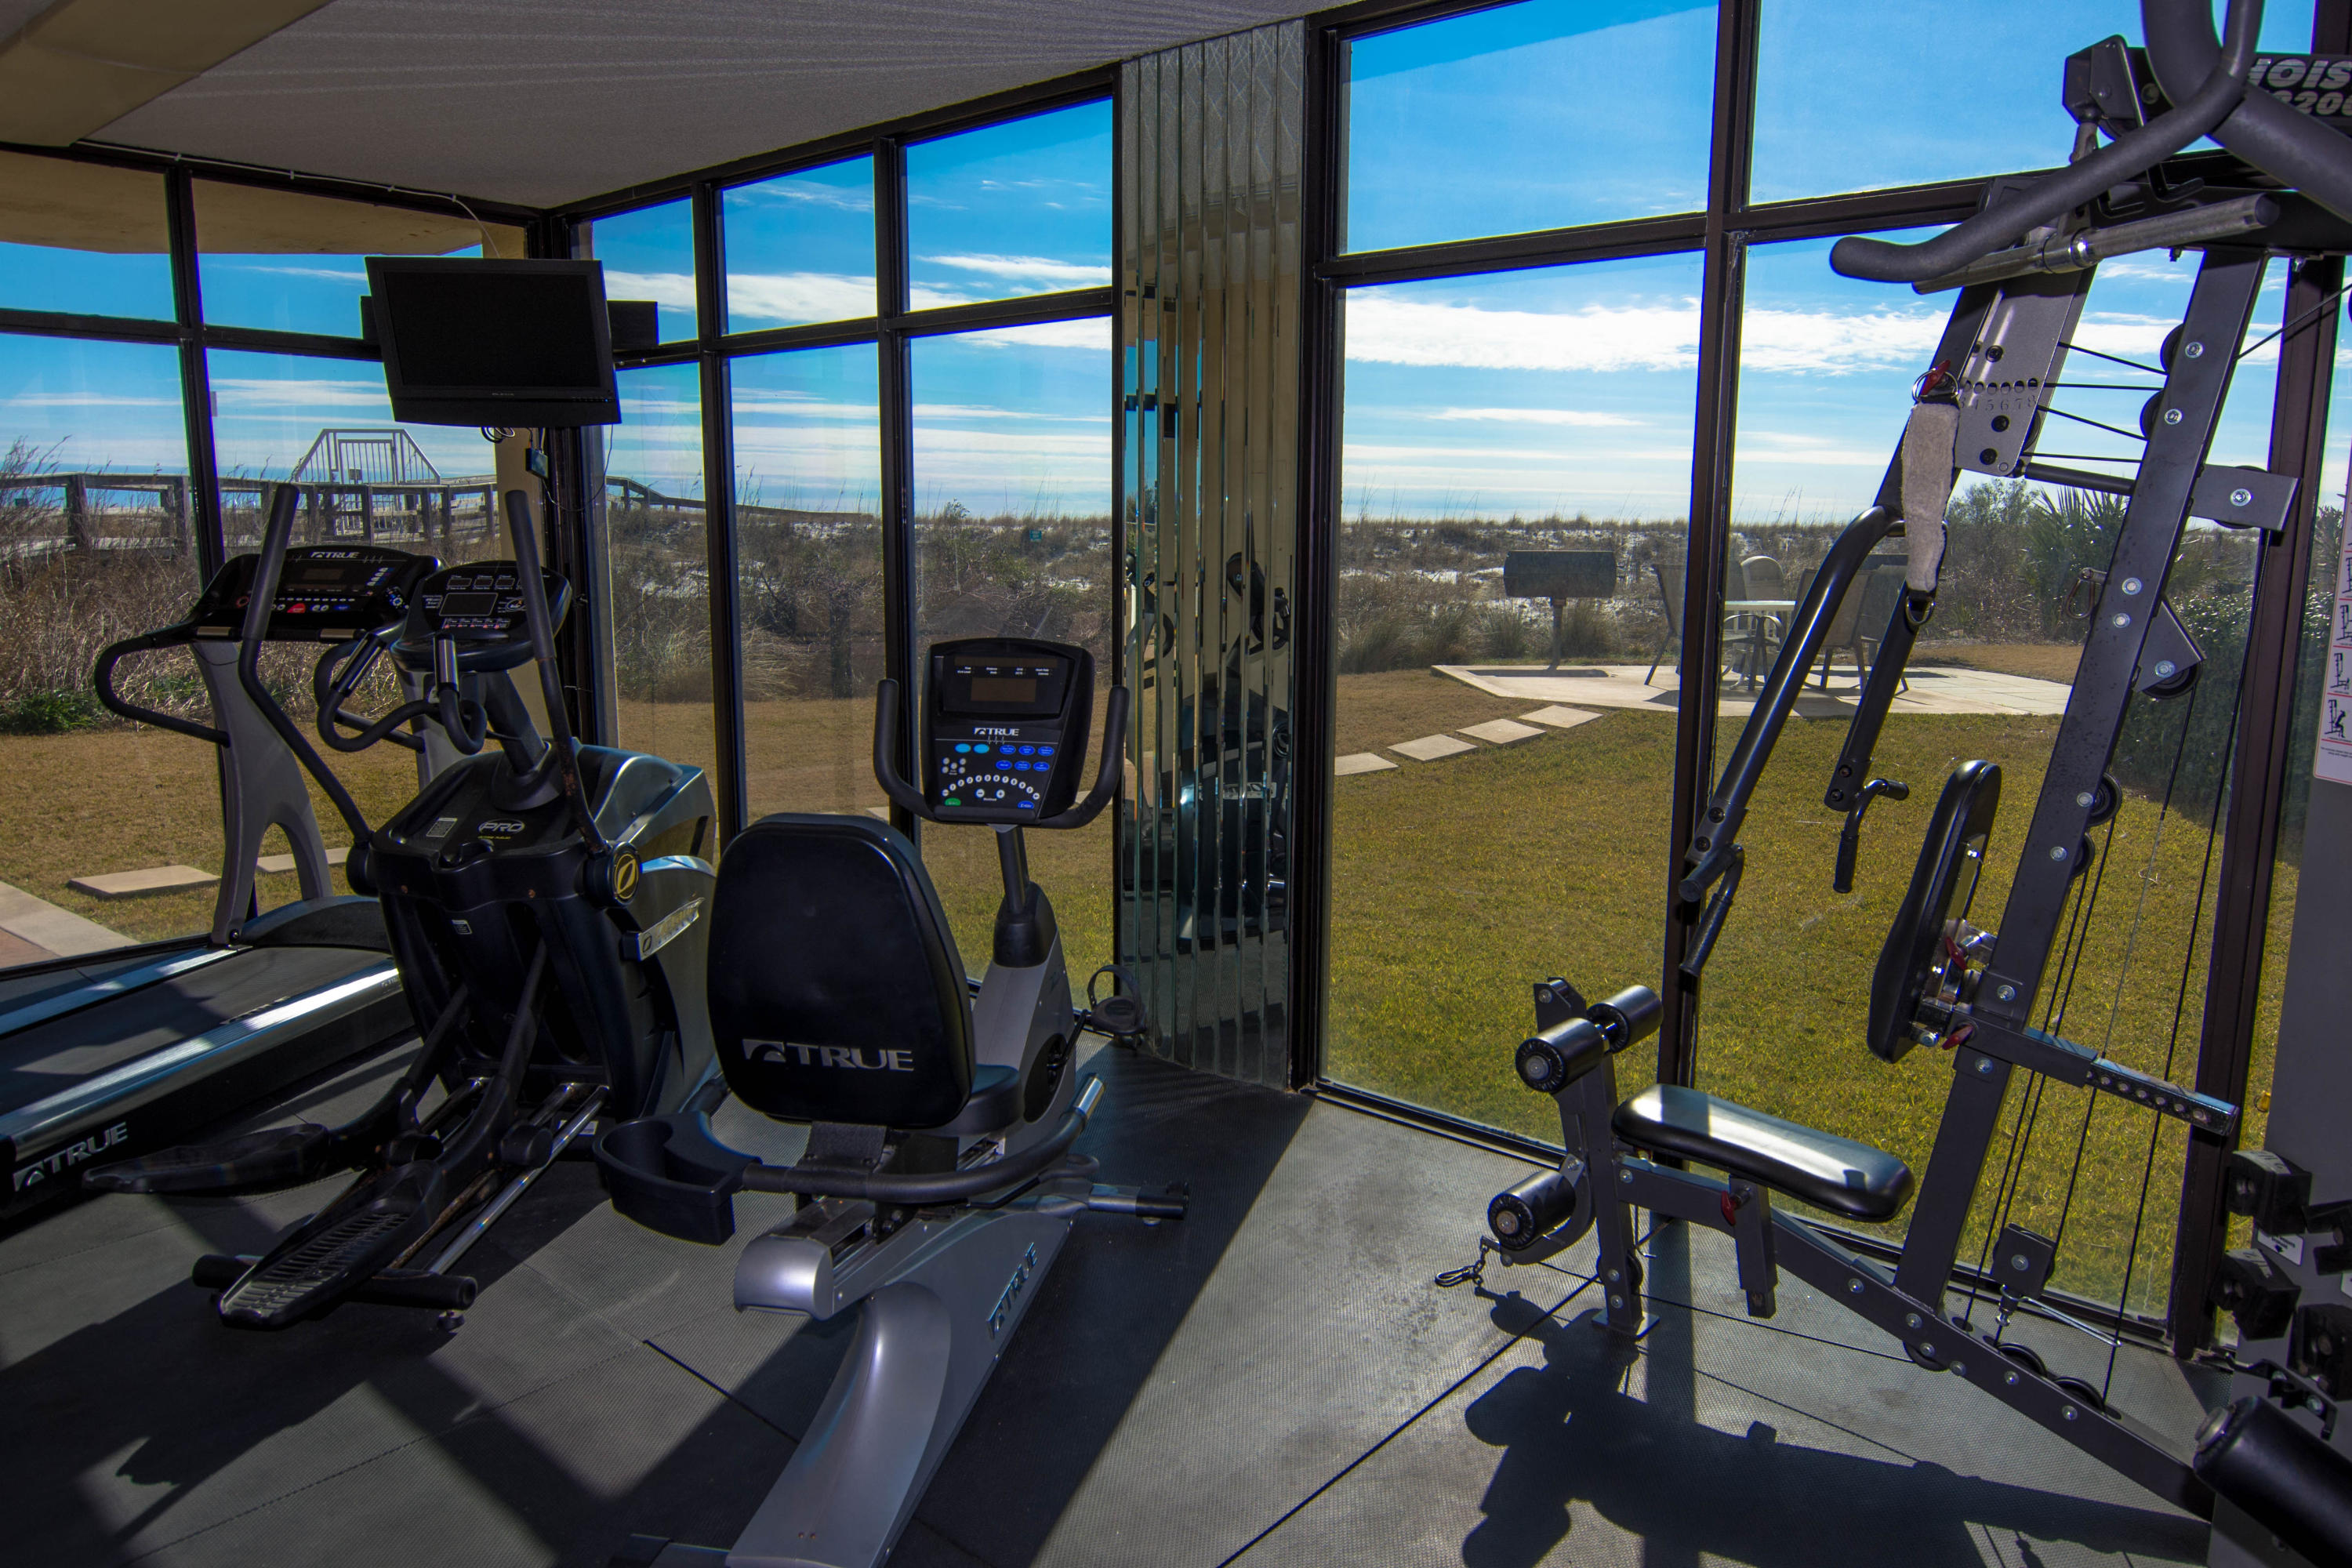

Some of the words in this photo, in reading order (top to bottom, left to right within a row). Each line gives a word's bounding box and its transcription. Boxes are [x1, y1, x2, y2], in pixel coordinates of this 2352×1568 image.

[1985, 399, 1994, 411] 5
[2000, 399, 2009, 411] 6
[2015, 397, 2024, 409] 7
[2027, 394, 2036, 408] 8
[985, 728, 1020, 736] TRUE
[479, 822, 524, 833] PRO
[786, 1043, 915, 1072] TRUE
[44, 1121, 129, 1174] TRUE
[1000, 1242, 1038, 1313] TRUE
